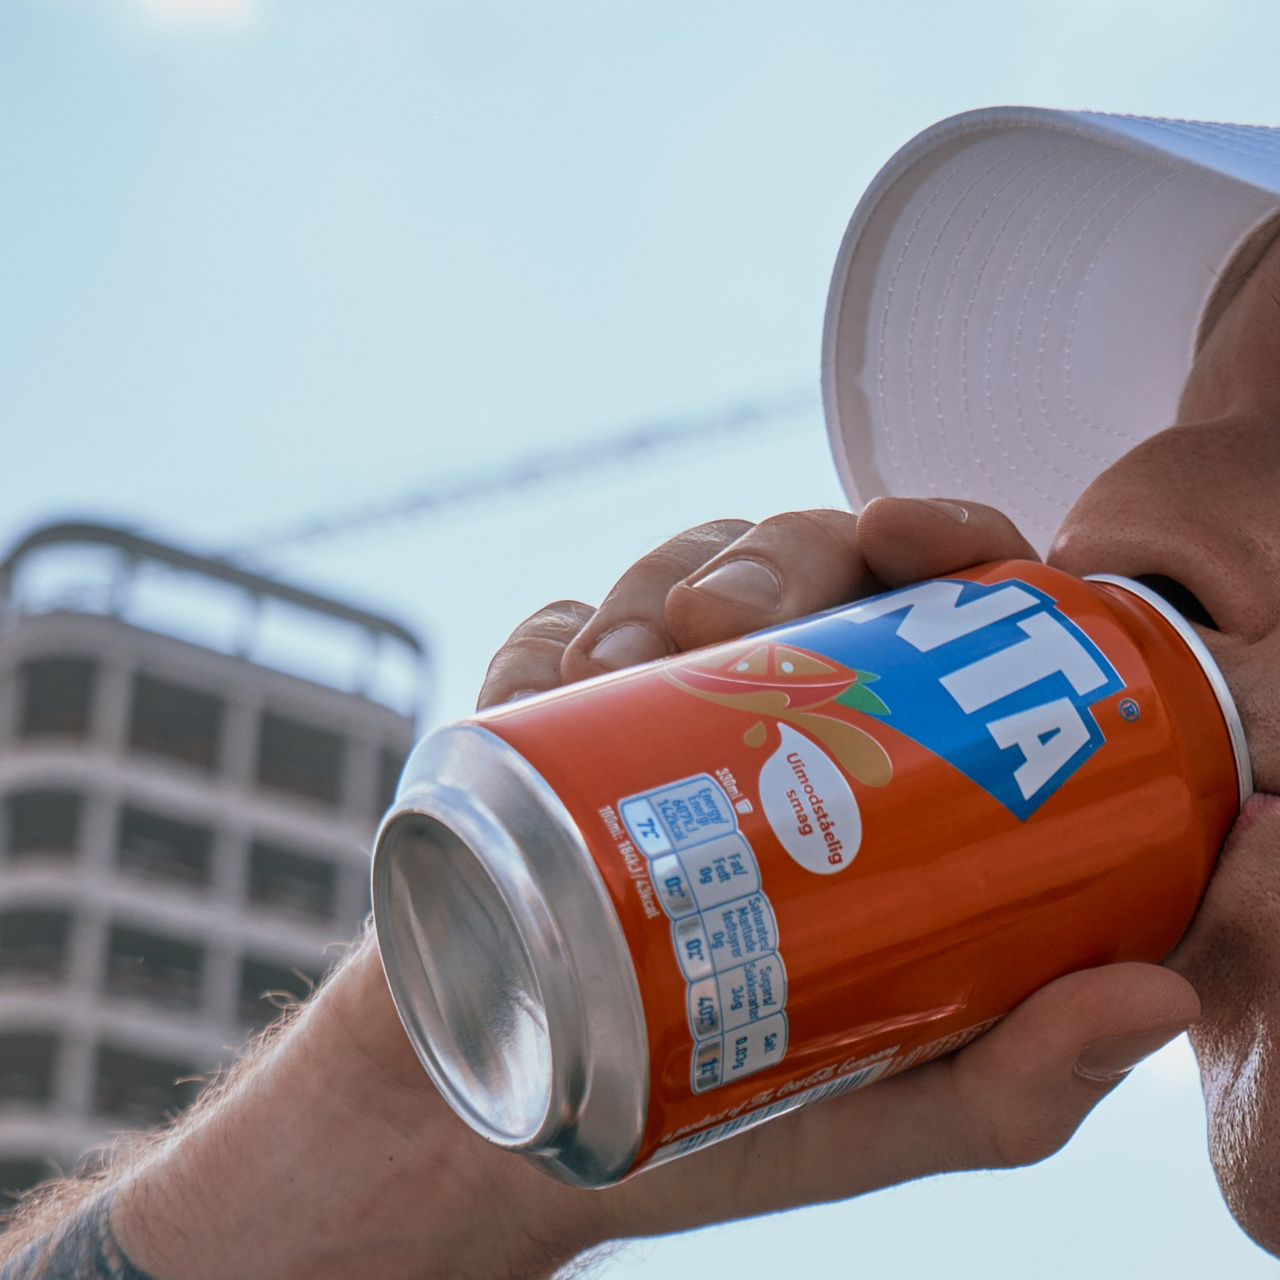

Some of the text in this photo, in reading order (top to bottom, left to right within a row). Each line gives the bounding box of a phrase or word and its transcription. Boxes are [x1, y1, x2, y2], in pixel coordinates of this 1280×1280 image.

[835, 581, 1109, 801] NTA
[716, 767, 743, 799] 330ml
[599, 805, 623, 841] 100ml:
[658, 799, 688, 842] 142kcal
[672, 800, 698, 833] 607kJ
[688, 795, 710, 827] Energi
[786, 752, 844, 865] Uimodståelig
[786, 789, 813, 836] smag
[700, 867, 713, 884] 0g
[713, 858, 731, 883] Fedt
[711, 931, 724, 949] 0g
[731, 986, 744, 1011] 36g
[732, 1036, 748, 1070] 0.03g
[764, 1033, 777, 1054] Salt
